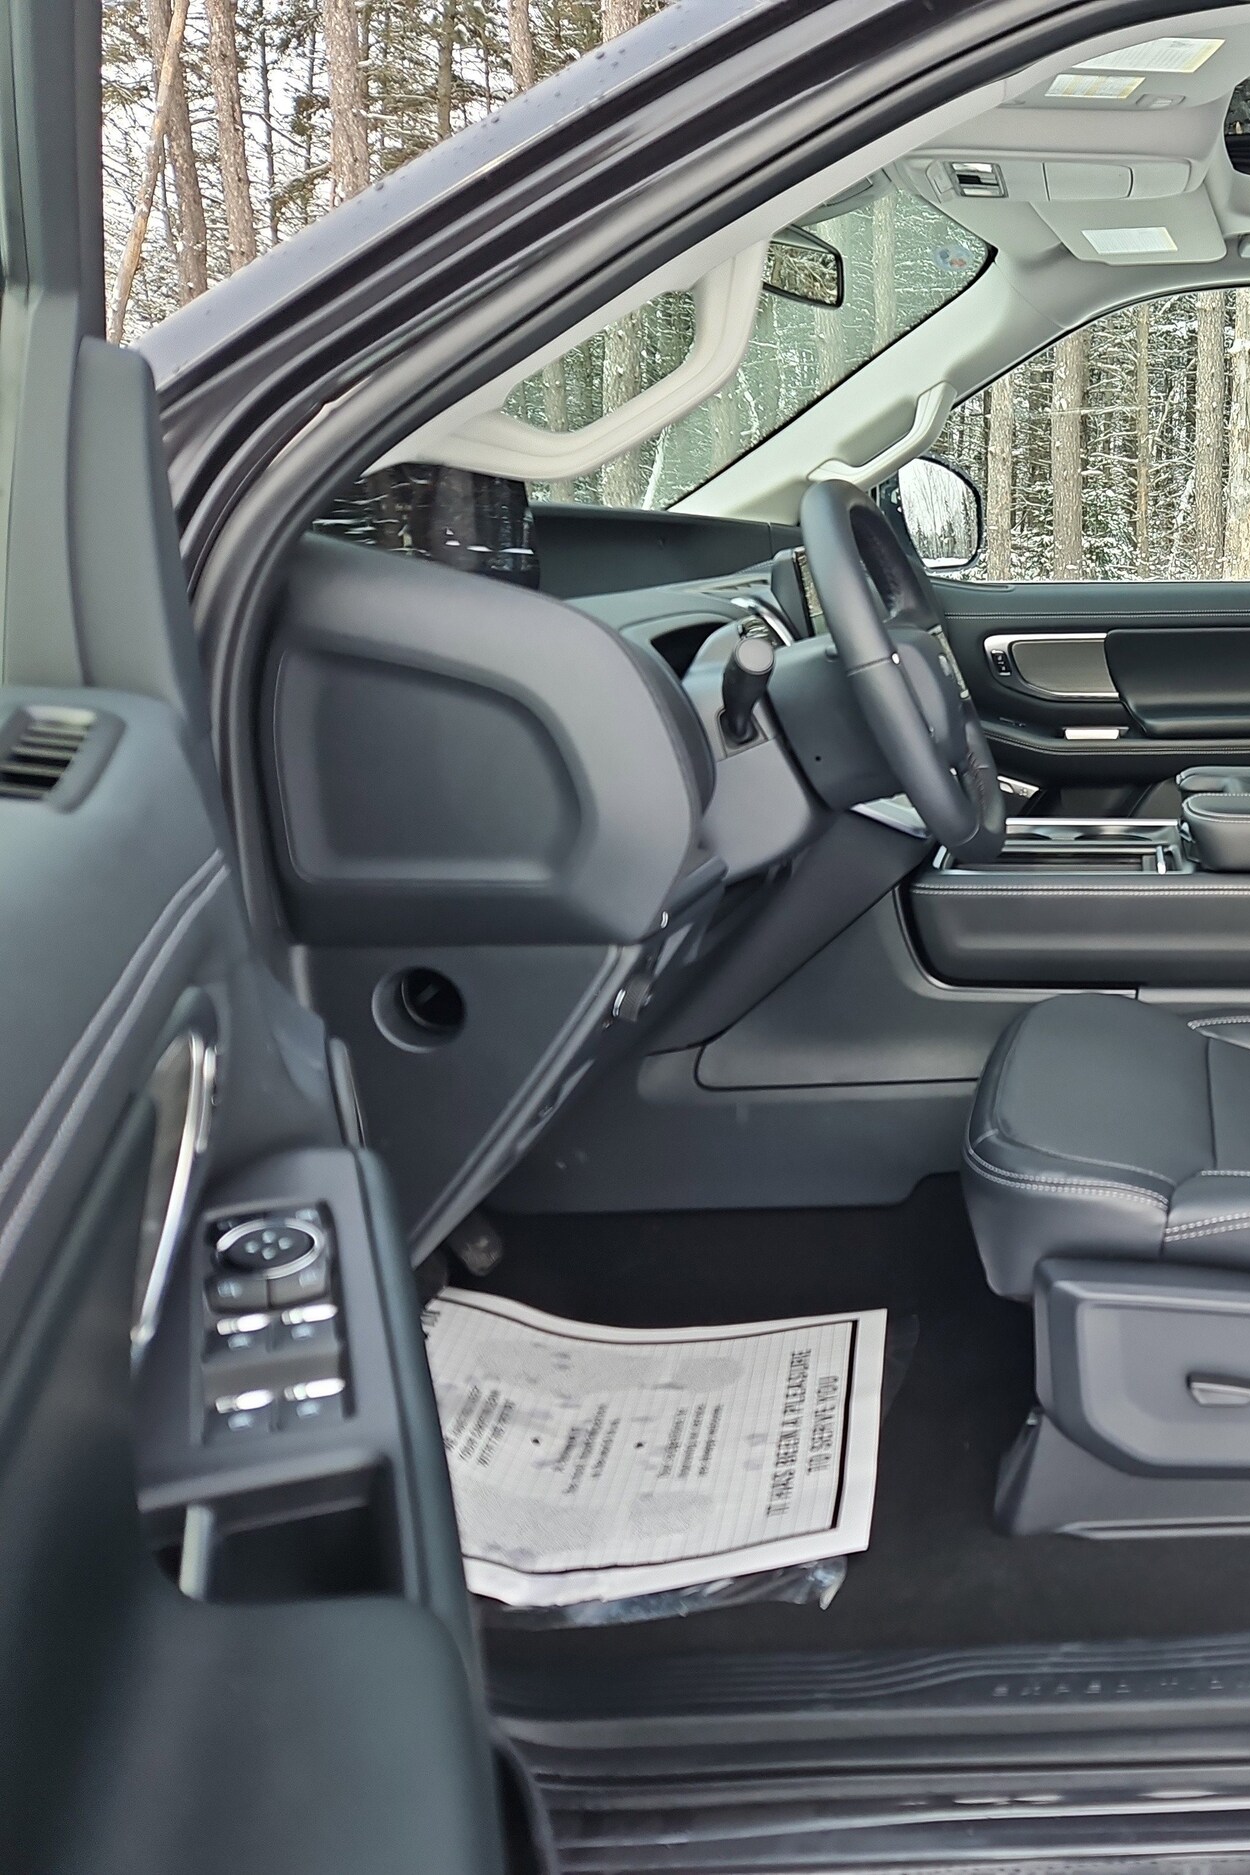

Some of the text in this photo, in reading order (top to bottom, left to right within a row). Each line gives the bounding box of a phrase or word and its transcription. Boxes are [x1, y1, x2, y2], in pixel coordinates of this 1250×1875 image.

[766, 1349, 811, 1517] IT HAS BEEN A PLEASURE
[806, 1375, 839, 1474] TO SERVE YOU
